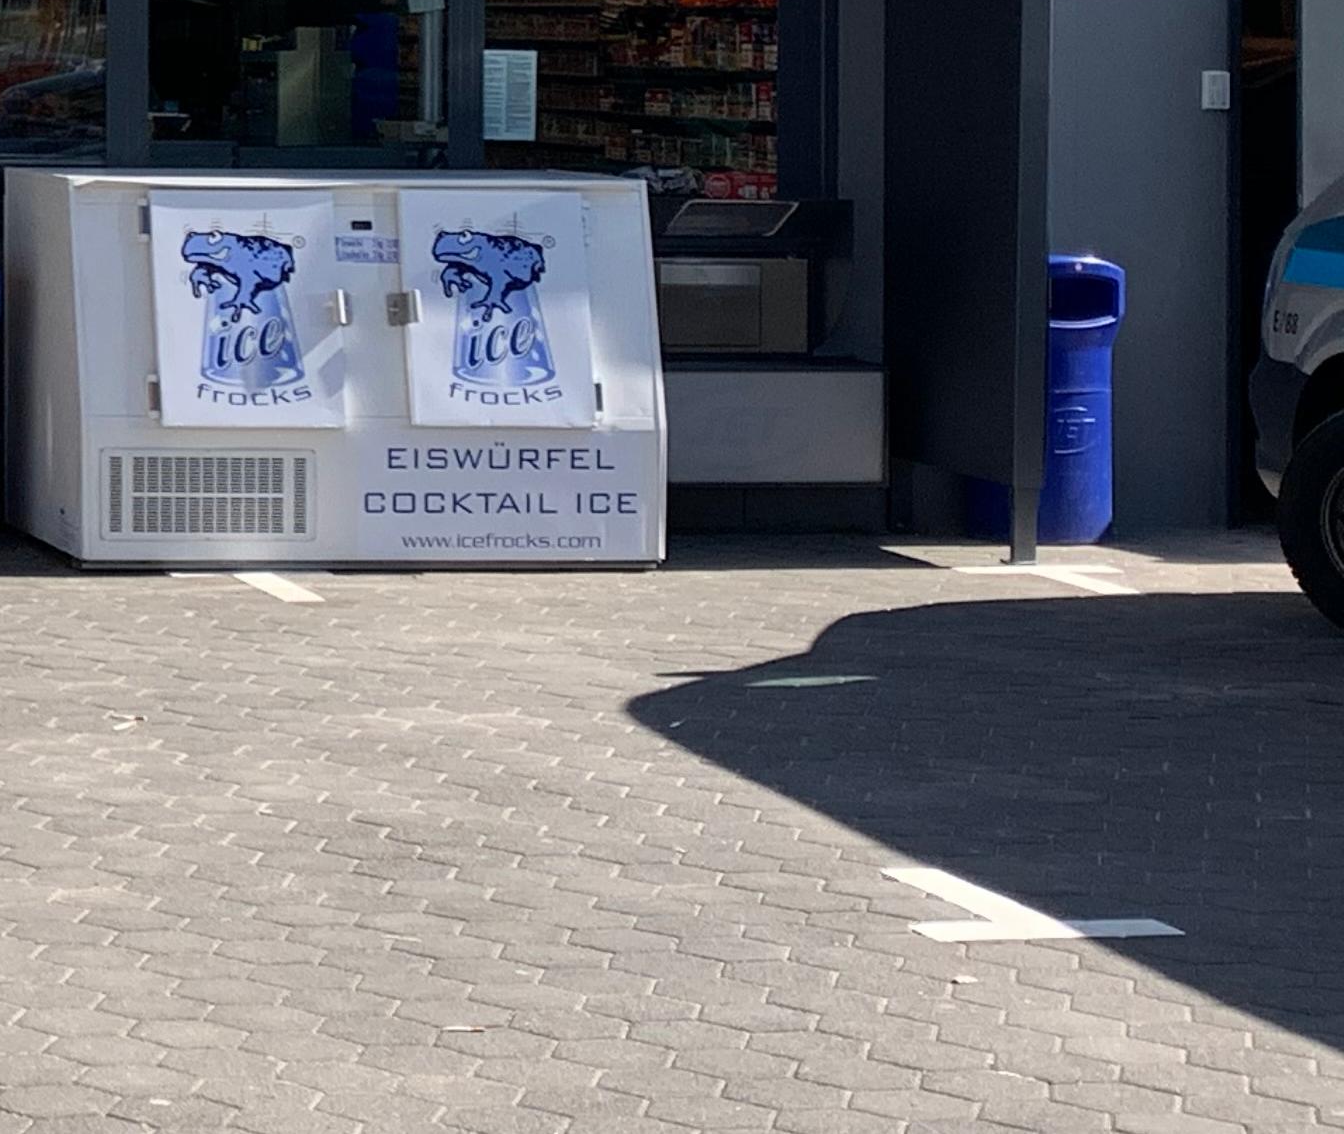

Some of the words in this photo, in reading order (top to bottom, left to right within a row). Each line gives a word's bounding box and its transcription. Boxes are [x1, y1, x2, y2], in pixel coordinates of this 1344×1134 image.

[216, 318, 287, 370] ice
[468, 318, 537, 370] ice
[196, 383, 312, 406] frocks
[449, 382, 563, 406] frocks
[387, 441, 615, 470] EISWÜRFEL
[363, 492, 558, 515] COCKTAIL
[576, 492, 638, 515] ICE
[401, 532, 602, 549] www.icefrocks.com
